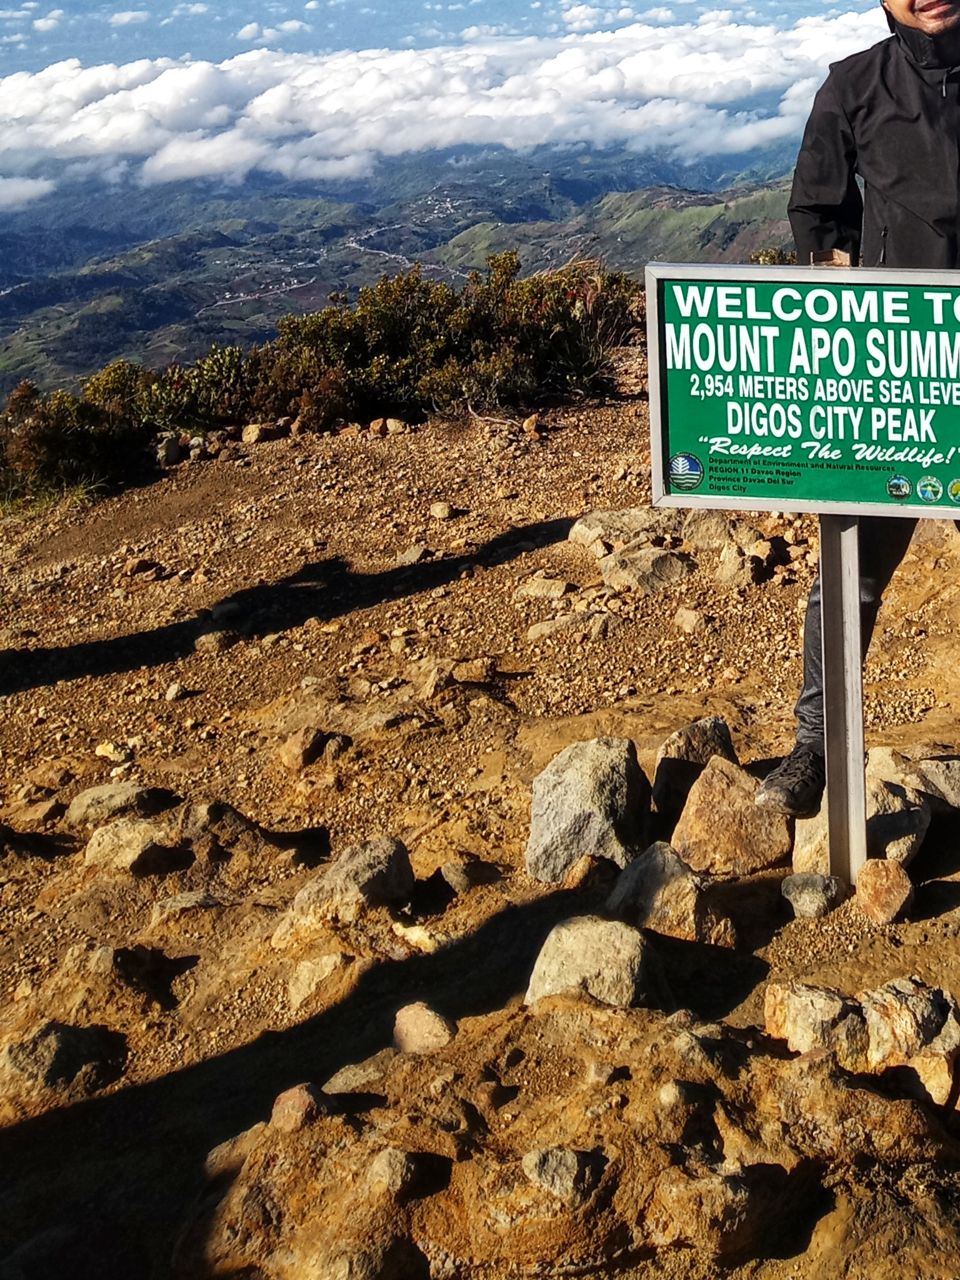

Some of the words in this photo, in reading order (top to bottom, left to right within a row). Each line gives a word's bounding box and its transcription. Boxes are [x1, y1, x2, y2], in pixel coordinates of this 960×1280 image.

[672, 285, 911, 324] WELCOME
[665, 323, 780, 373] MOUNT
[790, 327, 855, 376] APO
[690, 375, 734, 400] 2,954
[740, 376, 808, 401] METERS
[814, 378, 873, 402] ABOVE
[879, 381, 914, 404] SEA
[727, 402, 802, 438] DIGOS
[809, 405, 864, 439] CITY
[872, 408, 937, 442] PEAK
[709, 457, 751, 465] Department
[763, 460, 808, 468] Environment
[800, 441, 842, 460] The
[732, 485, 746, 493] City
